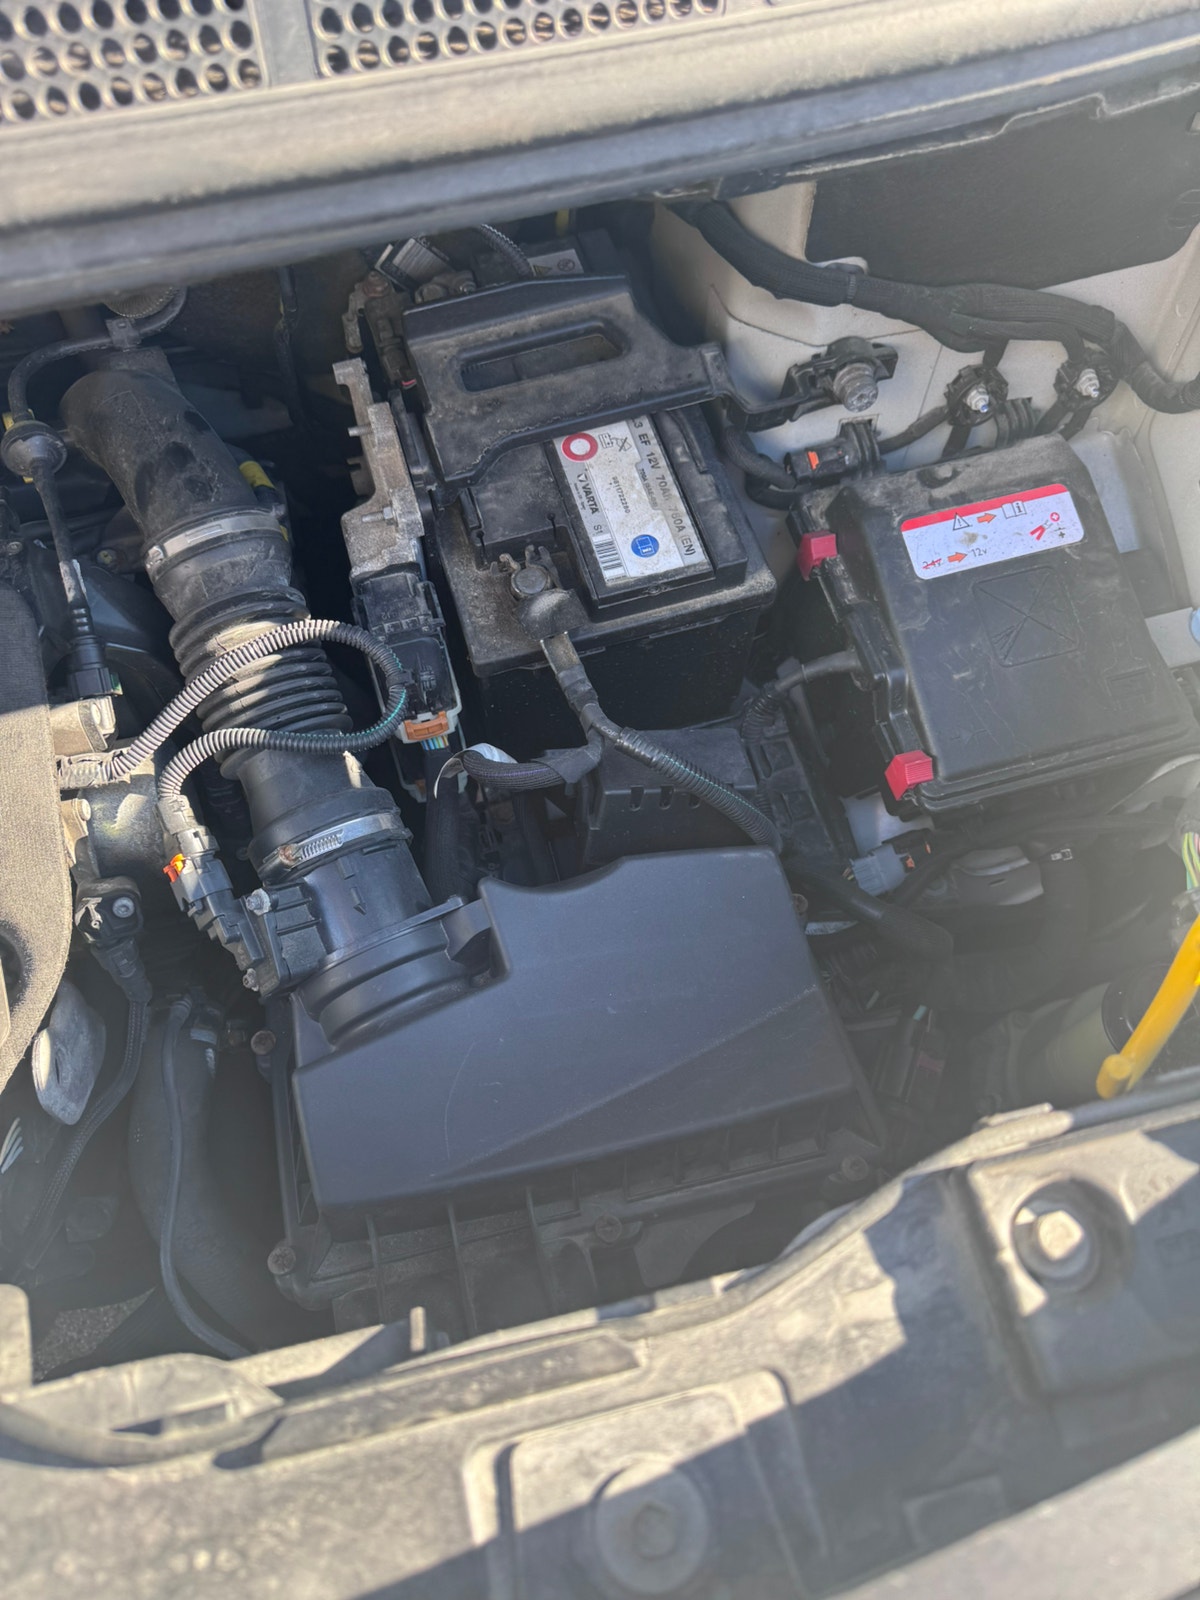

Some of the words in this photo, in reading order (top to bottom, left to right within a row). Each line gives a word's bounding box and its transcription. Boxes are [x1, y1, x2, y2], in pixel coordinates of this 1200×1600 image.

[582, 483, 599, 514] VARTA
[638, 433, 651, 446] EF
[646, 452, 661, 469] 12V
[680, 534, 697, 556] (EN)
